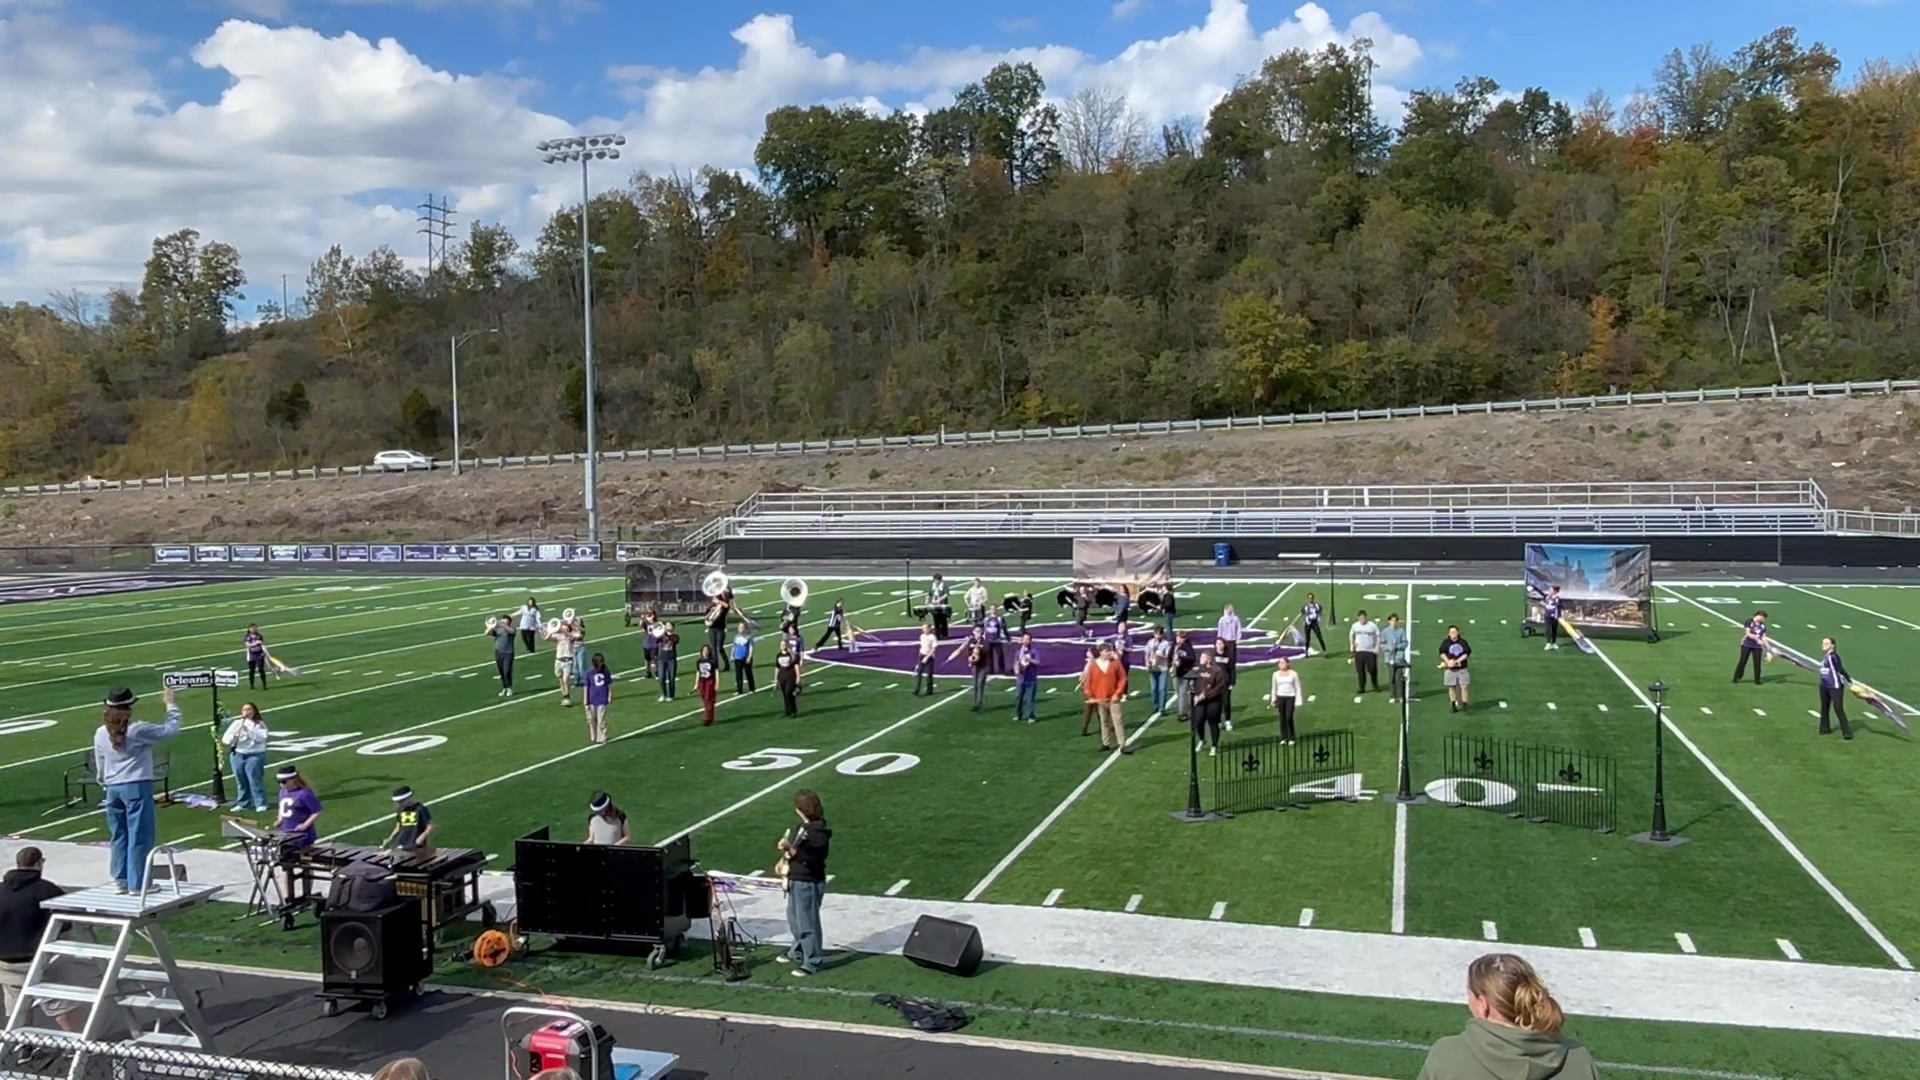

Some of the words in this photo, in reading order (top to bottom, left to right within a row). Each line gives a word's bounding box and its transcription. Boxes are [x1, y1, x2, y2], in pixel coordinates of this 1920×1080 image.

[166, 676, 209, 685] Orleans
[594, 673, 605, 686] C
[279, 797, 294, 817] C
